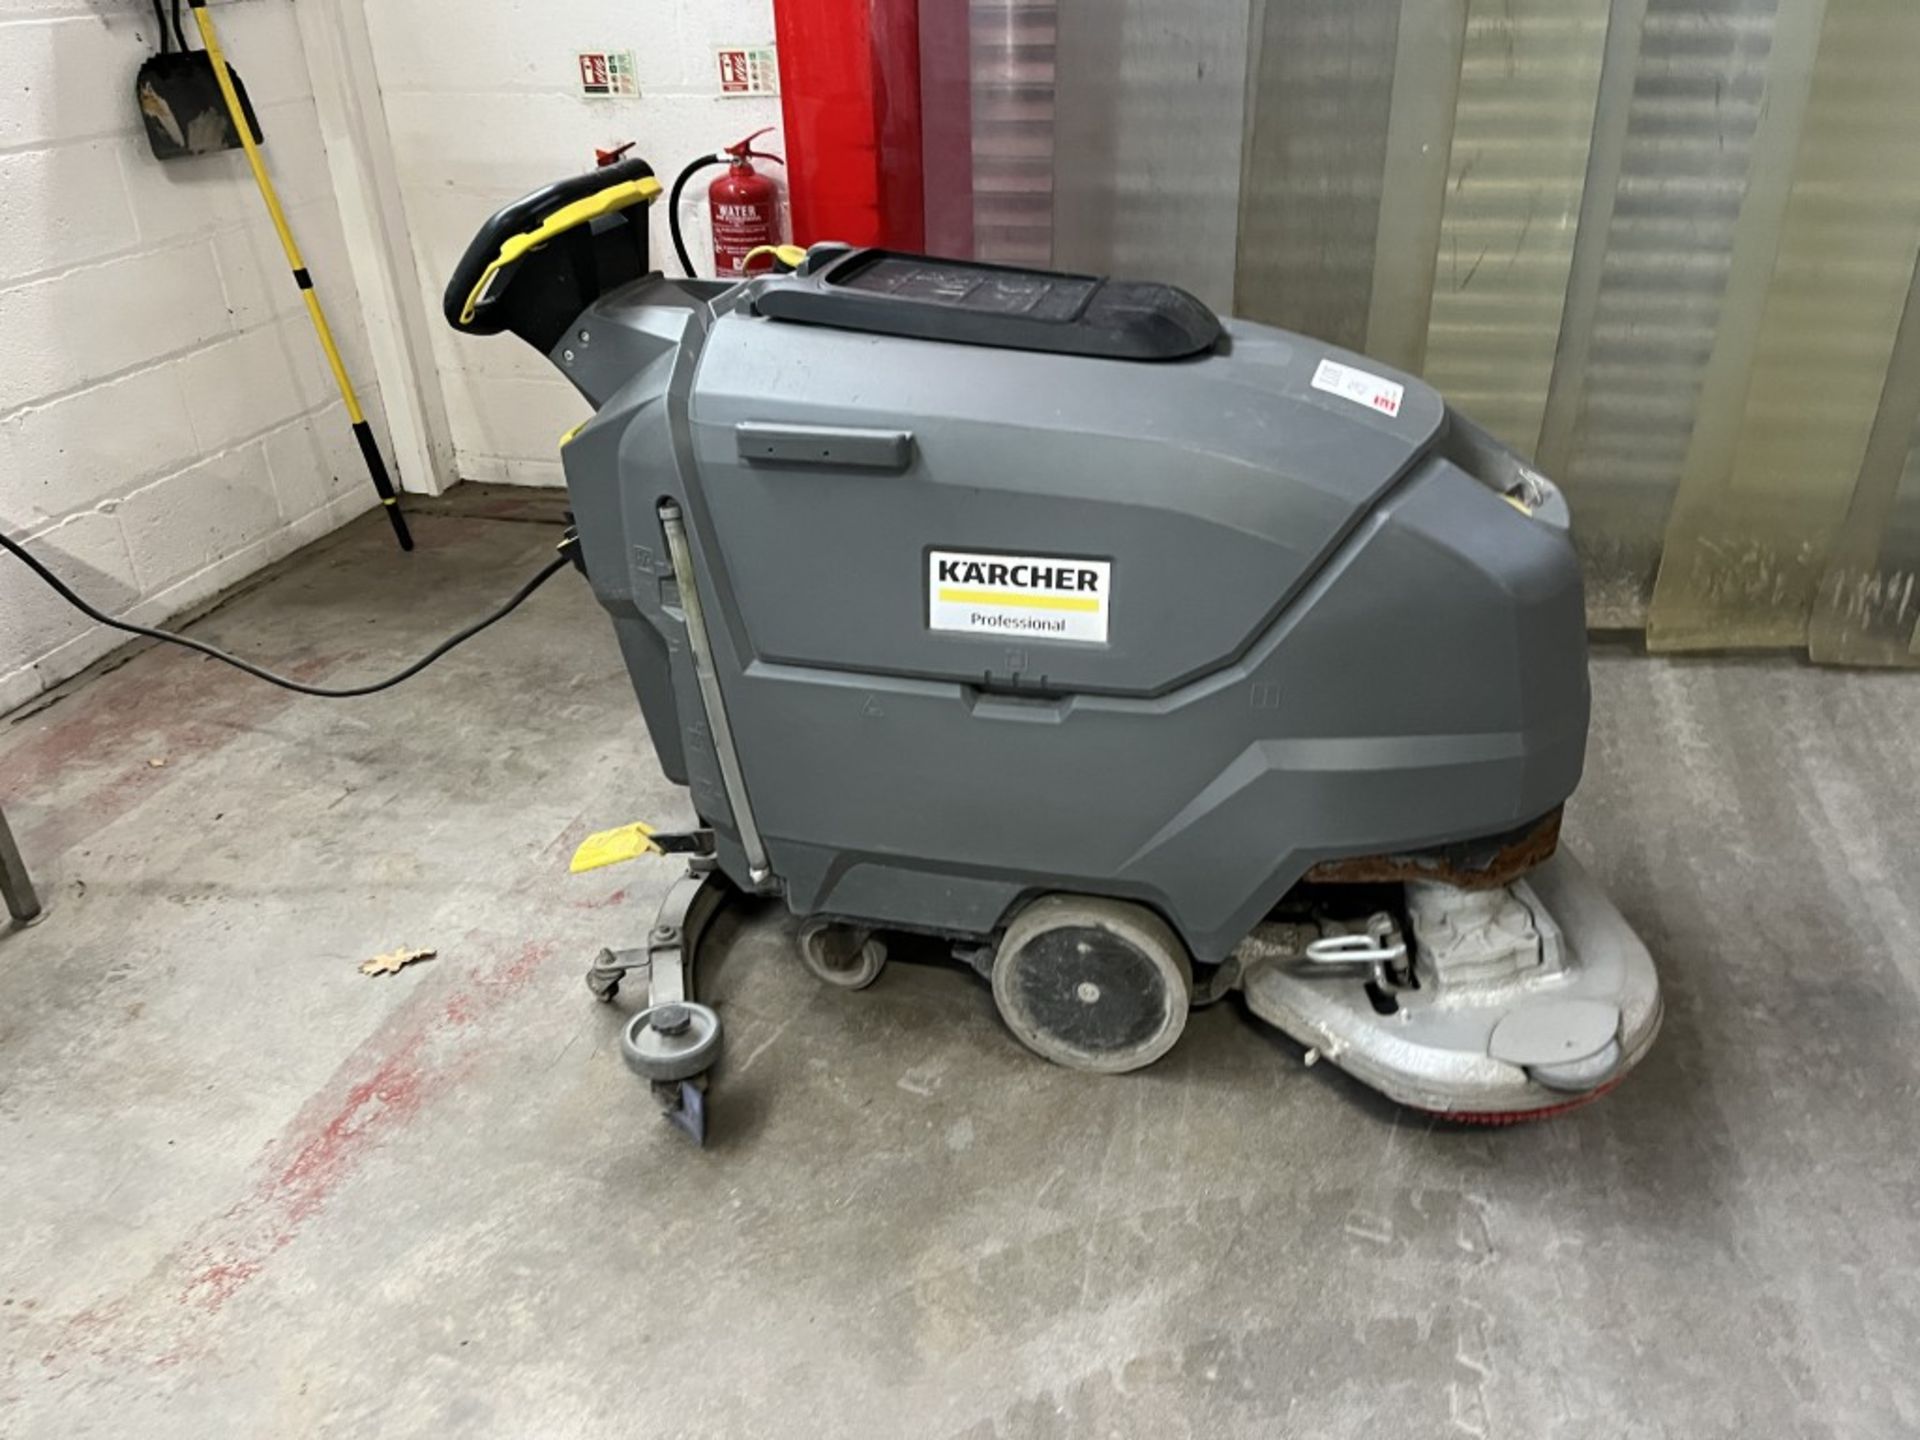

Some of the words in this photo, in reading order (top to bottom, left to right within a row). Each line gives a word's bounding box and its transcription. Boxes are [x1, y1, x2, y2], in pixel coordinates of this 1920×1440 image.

[719, 205, 756, 216] WATER
[939, 560, 1098, 591] KÄRCHER
[971, 612, 1066, 632] Professional
